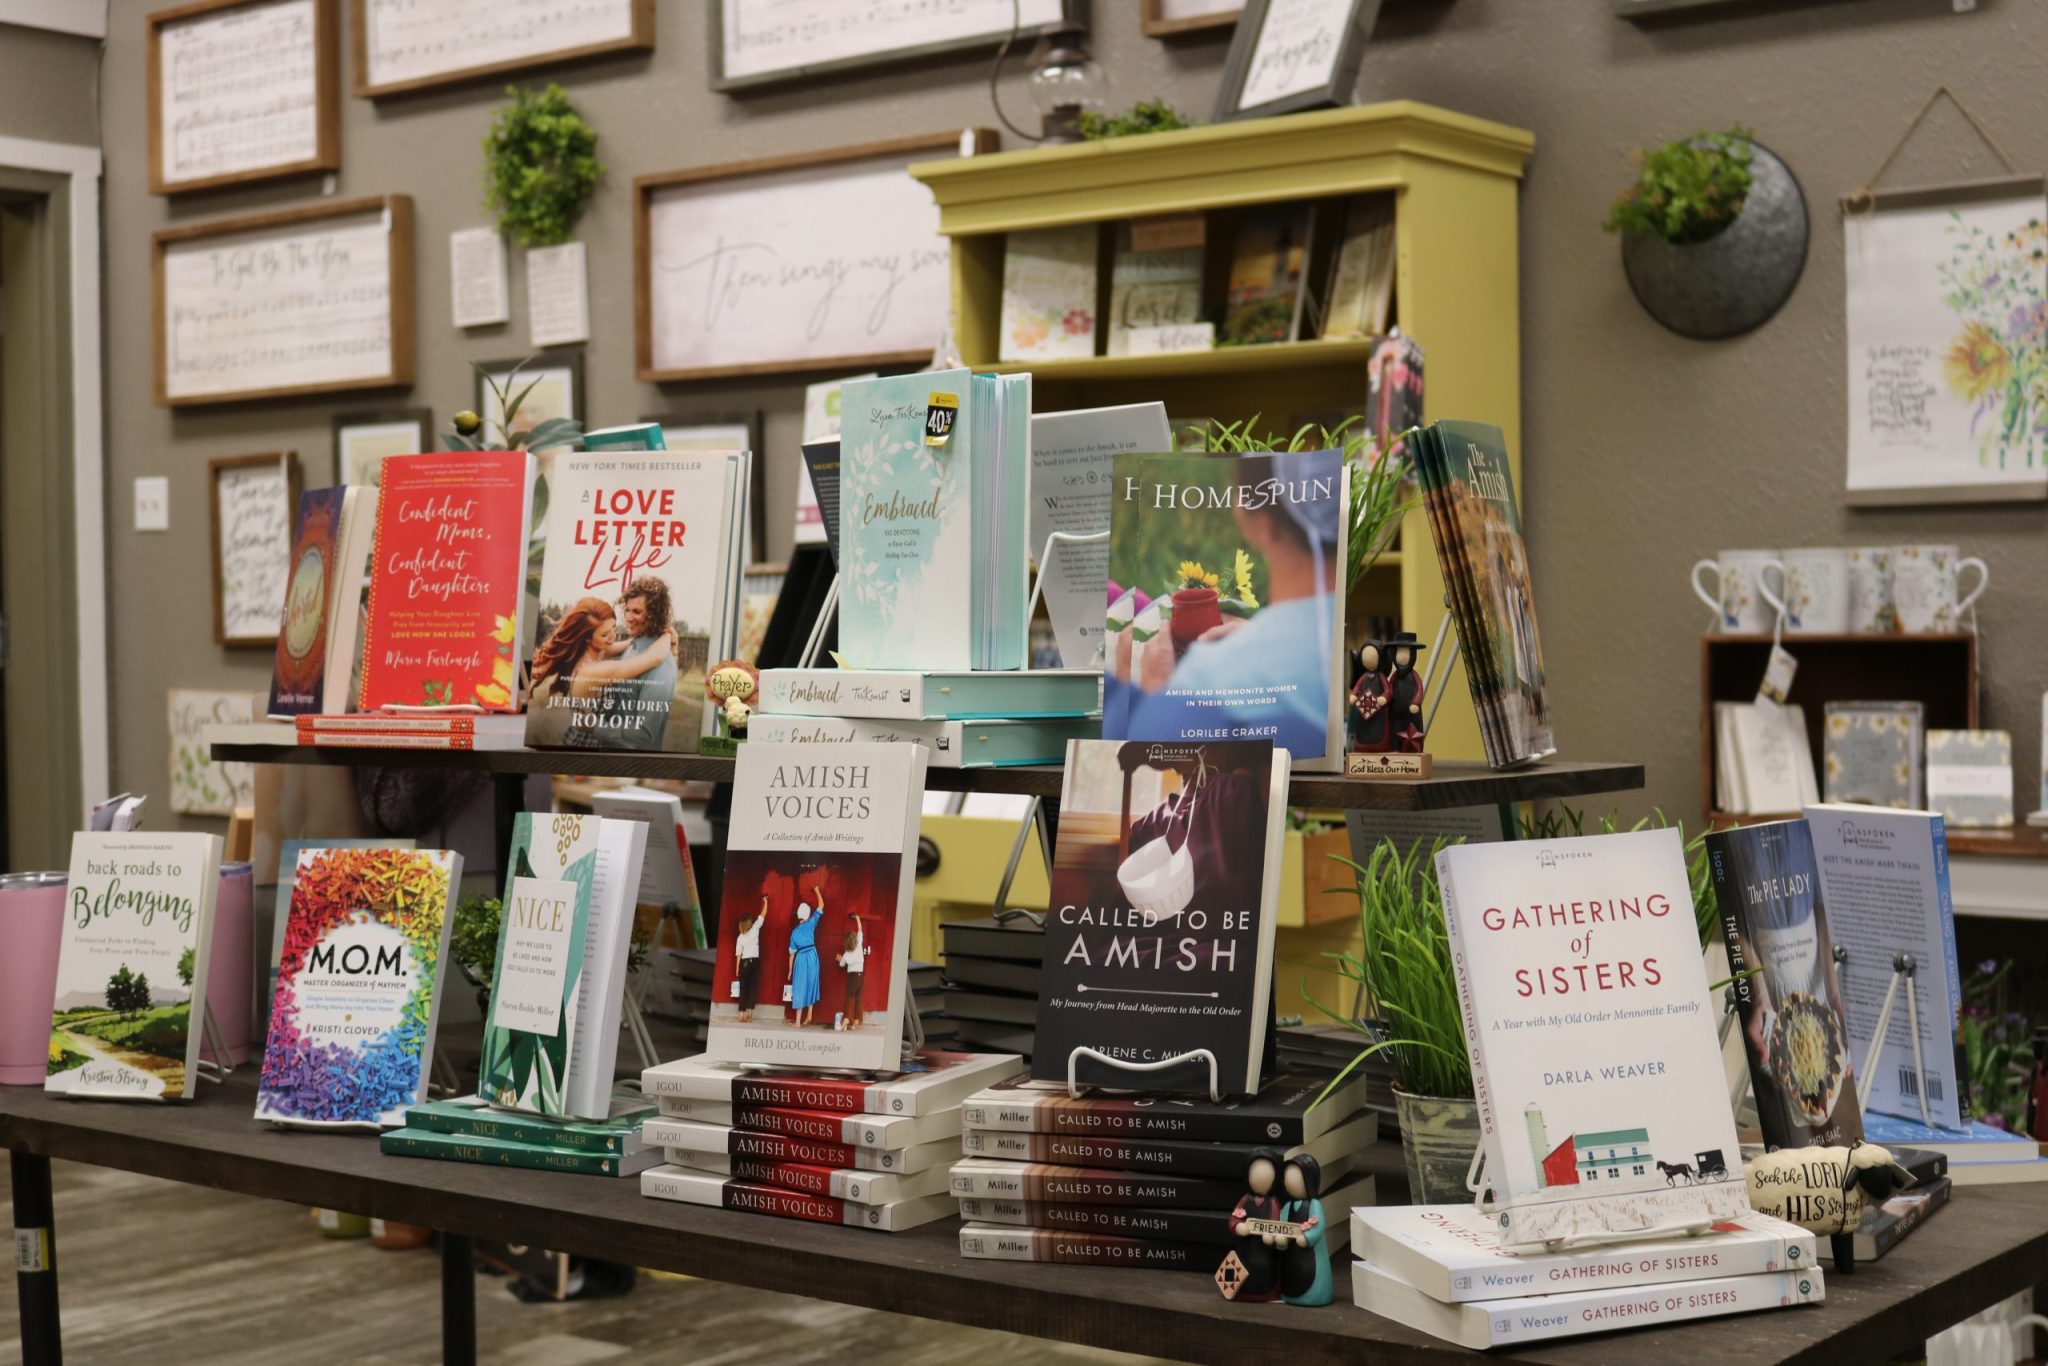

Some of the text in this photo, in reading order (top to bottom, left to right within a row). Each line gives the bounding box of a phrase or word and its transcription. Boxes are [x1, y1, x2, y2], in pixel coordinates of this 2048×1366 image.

[569, 462, 702, 470] NEW YORK TIMES BESTSELLER
[1467, 442, 1485, 467] The
[1467, 456, 1510, 502] Amish
[594, 489, 675, 515] LOVE
[863, 486, 947, 525] Embraced
[1153, 477, 1333, 510] HOMESPUN
[399, 495, 479, 523] Confident
[574, 520, 686, 547] LETTER
[388, 547, 474, 576] Confident
[583, 534, 673, 596] Life
[407, 572, 491, 602] Daughters
[712, 673, 752, 699] Prayer
[789, 680, 844, 704] Embraced
[1166, 689, 1193, 697] AMISH
[1215, 688, 1264, 696] MENNONITE
[1266, 684, 1298, 694] WOMEN
[547, 696, 672, 713] JEREMY AUDREY
[1246, 697, 1277, 705] WORDS
[571, 712, 646, 730] ROLOFF
[1181, 726, 1278, 738] LORILEE CRAKER
[768, 765, 870, 788] AMISH
[1350, 764, 1419, 773] God Bless Our Home
[764, 795, 871, 819] VOICES
[763, 832, 864, 844] A Collection of Amish Writings
[87, 860, 182, 876] back roads to
[1712, 850, 1725, 882] Isaac
[1748, 872, 1811, 905] The PIE LADY
[71, 878, 196, 933] Belonging
[513, 897, 566, 932] NICE
[1059, 905, 1250, 930] CALLED TO BE
[1483, 894, 1670, 931] GATHERING
[1725, 914, 1739, 940] THE
[1063, 933, 1237, 972] AMISH
[1570, 930, 1593, 959] of
[1731, 944, 1744, 965] PIE
[308, 944, 407, 976] M.O.M.
[1515, 958, 1662, 998] SISTERS
[536, 1004, 555, 1016] Miller
[1050, 998, 1242, 1016] My Journey from Head Majorette to the Old Order
[1492, 1001, 1701, 1031] A Year with My Old Order Mennonite Family
[313, 1025, 380, 1035] KRISTI CLOVER
[744, 1038, 842, 1055] BRAD IGOU, compiler
[1455, 952, 1493, 1135] GATHERING OF SISTERS
[115, 1068, 149, 1090] Strong
[1544, 1061, 1666, 1086] DARLA WEAVER
[656, 1081, 854, 1108] IGOU AMISH VOICES
[472, 1121, 586, 1145] NICE MILLER
[1000, 1112, 1187, 1130] Miller CALLED TO BE AMISH
[1825, 1126, 1843, 1142] ISAAC
[454, 1146, 579, 1167] NICE MILLER
[656, 1131, 845, 1163] IGOU AMISH VOICES
[1755, 1161, 1843, 1190] Seek the LORD
[654, 1183, 834, 1218] IGOU AMISH VOICES
[987, 1180, 1176, 1198] Miller CALLED TO BE AMISH
[1759, 1203, 1783, 1217] and
[1786, 1195, 1825, 1222] HIS
[1253, 1222, 1294, 1235] FRIENDS
[998, 1241, 1186, 1260] Miller CALLED TO BE AMISH
[1483, 1254, 1719, 1286] Weaver GATHERING OF SISTERS
[1521, 1291, 1737, 1329] Weaver GATHERING OF SISTERS
